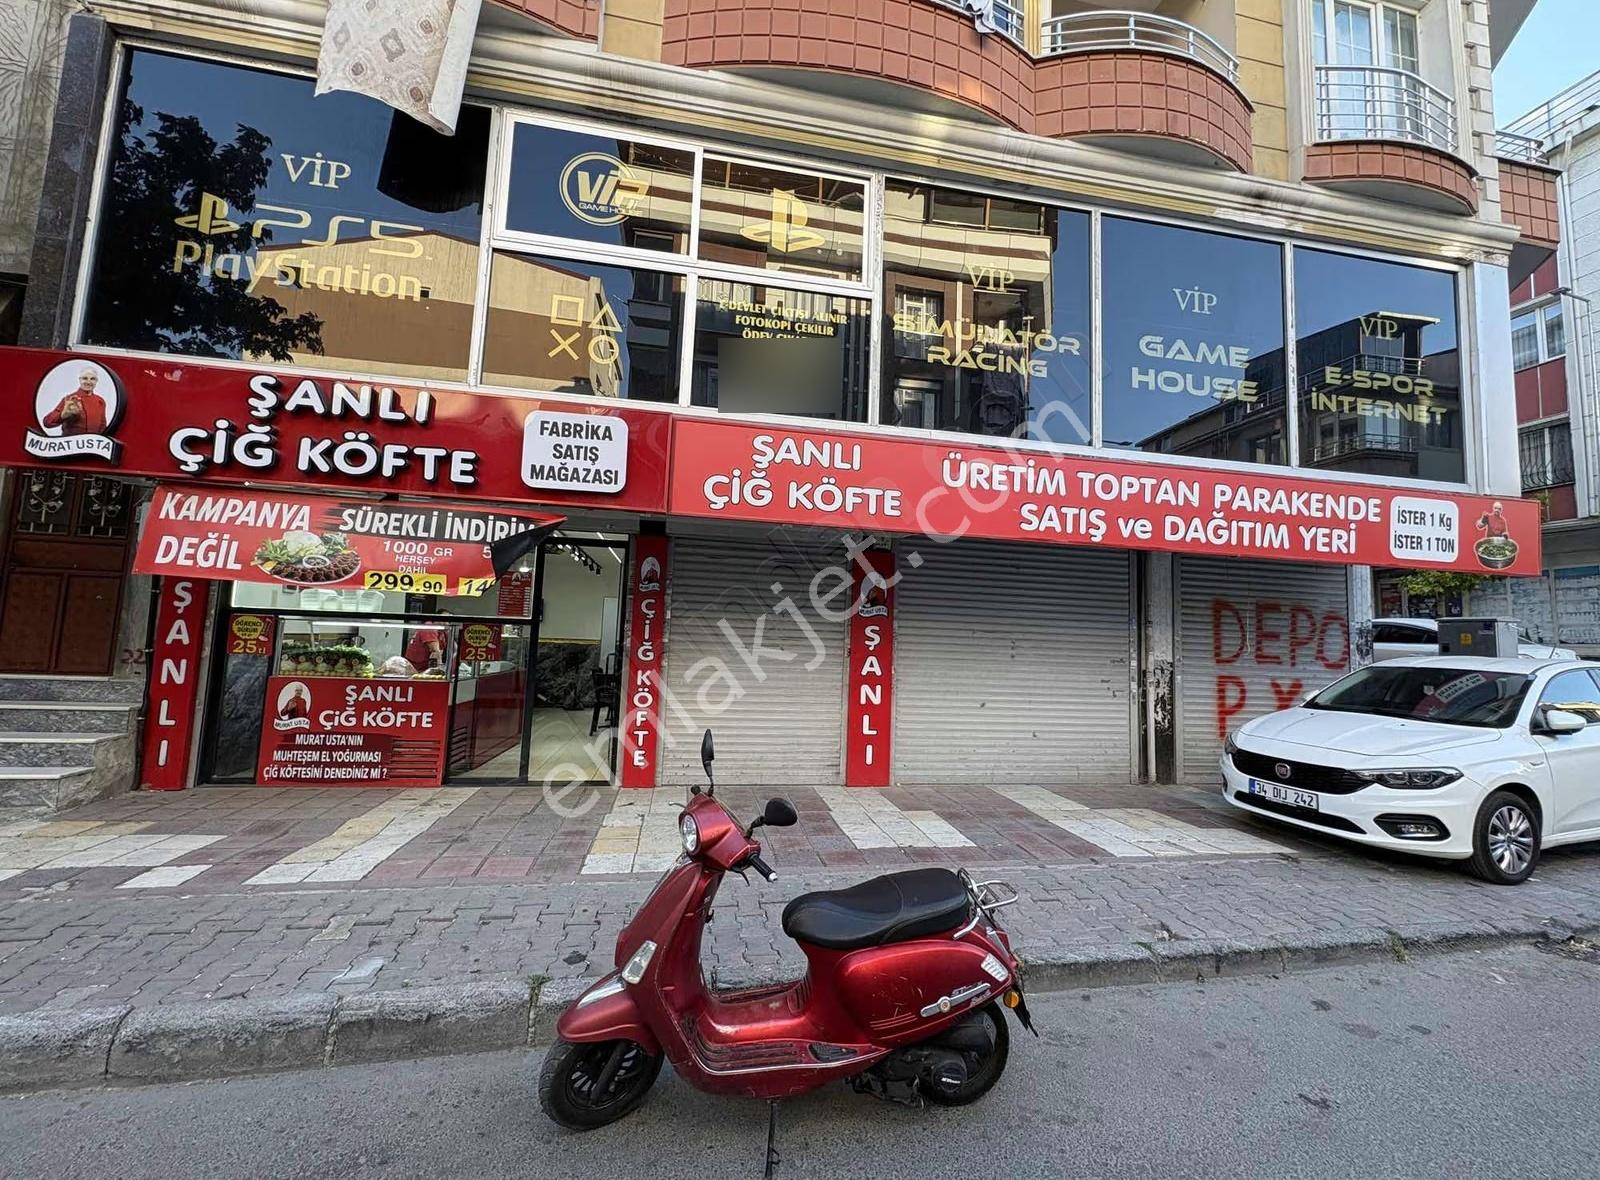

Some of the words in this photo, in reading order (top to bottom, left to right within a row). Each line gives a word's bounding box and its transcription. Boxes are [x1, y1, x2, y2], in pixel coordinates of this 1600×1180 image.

[252, 204, 425, 258] PS5
[173, 240, 421, 302] PlayStation
[1139, 335, 1250, 369] GAME
[247, 374, 431, 422] ŞANLI
[1131, 366, 1259, 402] HOUSE
[1325, 366, 1434, 397] E-SPOR
[1311, 387, 1447, 425] İNTERNET
[27, 436, 71, 452] MURAT
[76, 434, 112, 452] USTA
[539, 418, 614, 442] FABRİKA
[168, 418, 275, 473] ÇİĞ
[297, 431, 477, 484] KÖFTE
[552, 443, 600, 465] SATIŞ
[752, 434, 862, 471] ŞANLI
[530, 461, 619, 486] MAĞAZASI
[941, 451, 1067, 497] ÜRETİM
[1077, 470, 1200, 508] TOPTAN
[1214, 483, 1382, 523] PARAKENDE
[703, 468, 774, 511] ÇİĞ
[787, 475, 902, 516] KÖFTE
[159, 491, 311, 531] KAMPANYA
[338, 506, 438, 539] SÜREKLİ
[1397, 505, 1426, 526] İSTER
[1429, 512, 1435, 527] 1
[1438, 513, 1452, 531] Kg
[1019, 502, 1108, 543] SATIŞ
[1117, 516, 1153, 540] ve
[1164, 507, 1290, 548] DAĞITIM
[1298, 521, 1357, 555] YERİ
[1393, 530, 1423, 551] İSTER
[1426, 537, 1432, 551] 1
[1436, 537, 1455, 553] TON
[154, 532, 243, 570] DEĞİL
[383, 541, 428, 555] 1000
[433, 547, 454, 557] GR
[394, 554, 437, 565] HERŞEY
[367, 572, 443, 593] 299.90
[637, 599, 656, 661] ÇİĞ
[1212, 597, 1351, 670] DEPO
[157, 581, 194, 767] ŞANLI
[345, 685, 414, 705] ŞANLI
[860, 624, 883, 766] ŞANLI
[362, 707, 434, 728] KÖFTE
[633, 669, 653, 767] KÖFTE
[273, 750, 320, 764] MUHTEŞEM
[321, 751, 330, 762] EL
[332, 749, 382, 763] YOĞURMASI
[295, 734, 325, 746] MURAT
[263, 764, 279, 781] ÇİĞ
[280, 764, 322, 779] KÖFTESİNİ
[323, 765, 369, 779] DENEDİNİZ
[370, 765, 382, 779] Mİ
[381, 769, 388, 779] ?
[1256, 782, 1267, 795] 34
[1293, 791, 1314, 808] 242
